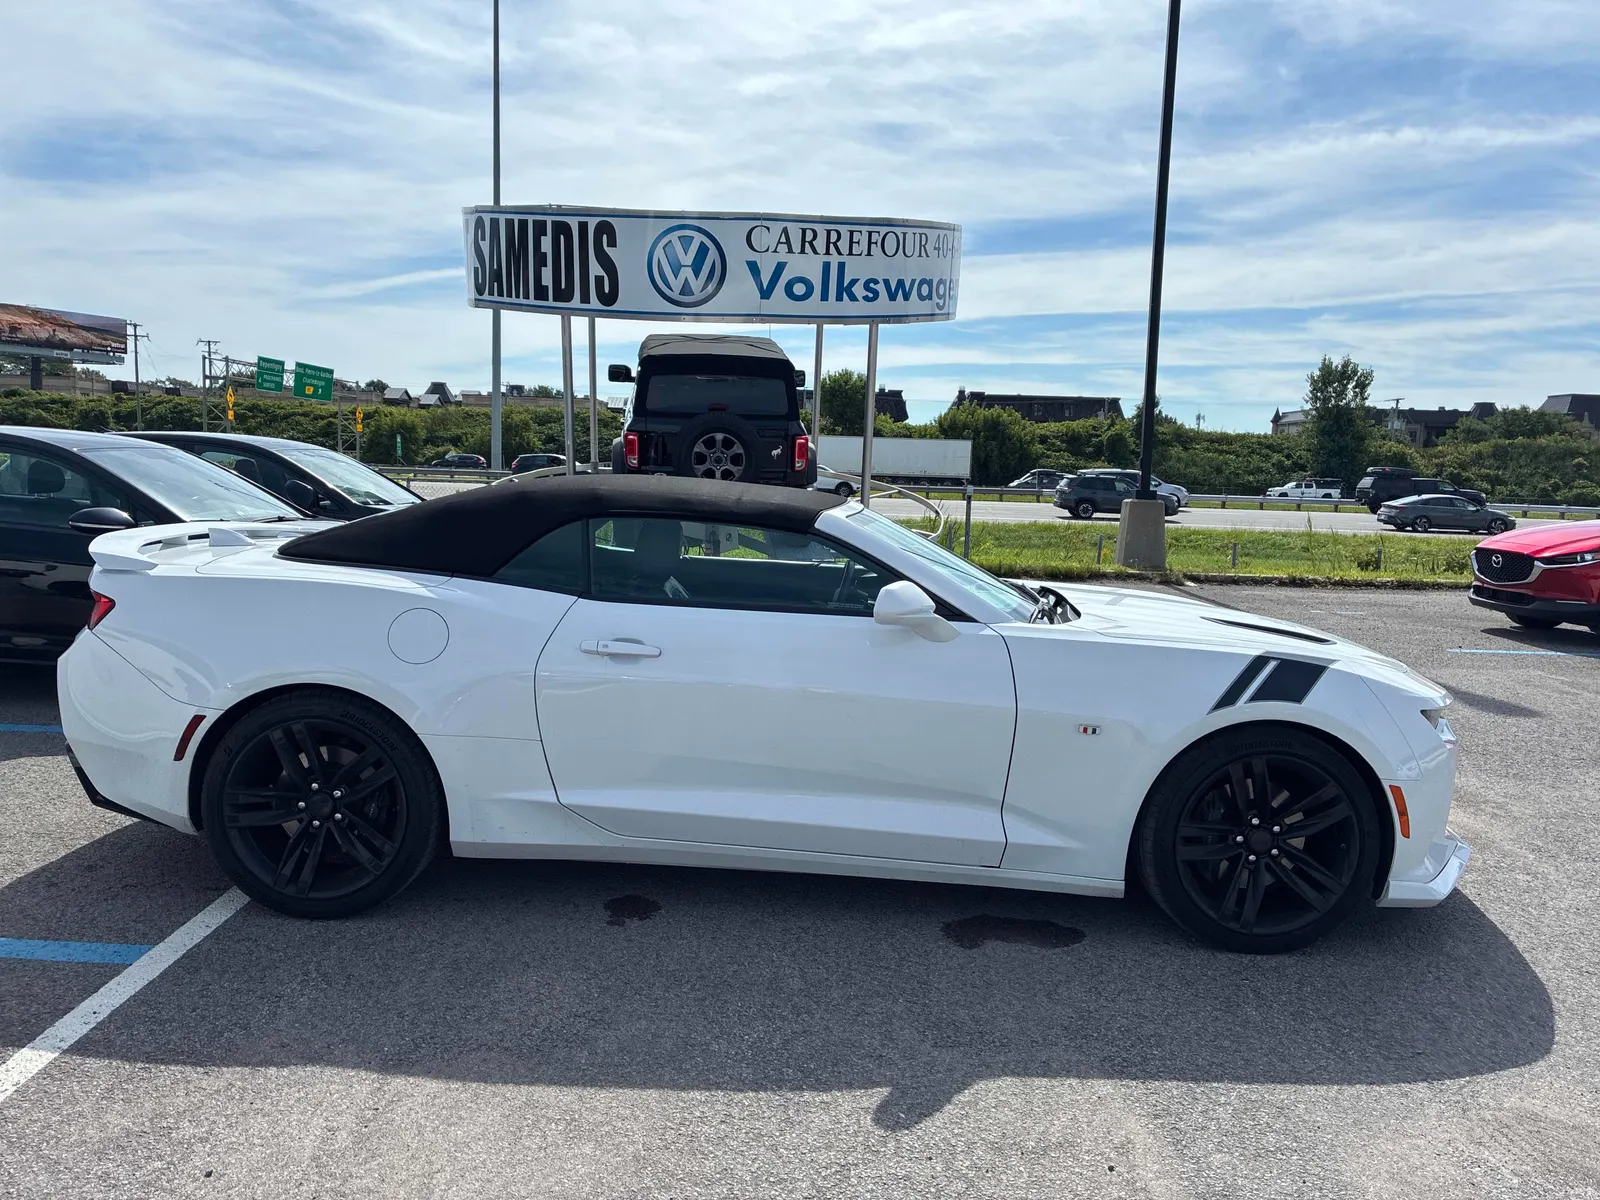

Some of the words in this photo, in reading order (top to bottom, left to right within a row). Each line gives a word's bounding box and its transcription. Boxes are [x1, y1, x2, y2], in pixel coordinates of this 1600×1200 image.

[473, 215, 619, 307] SAMEDIS
[744, 223, 931, 259] CARREFOUR
[260, 360, 282, 372] Repentigny
[340, 709, 400, 754] BRIDGESTONE
